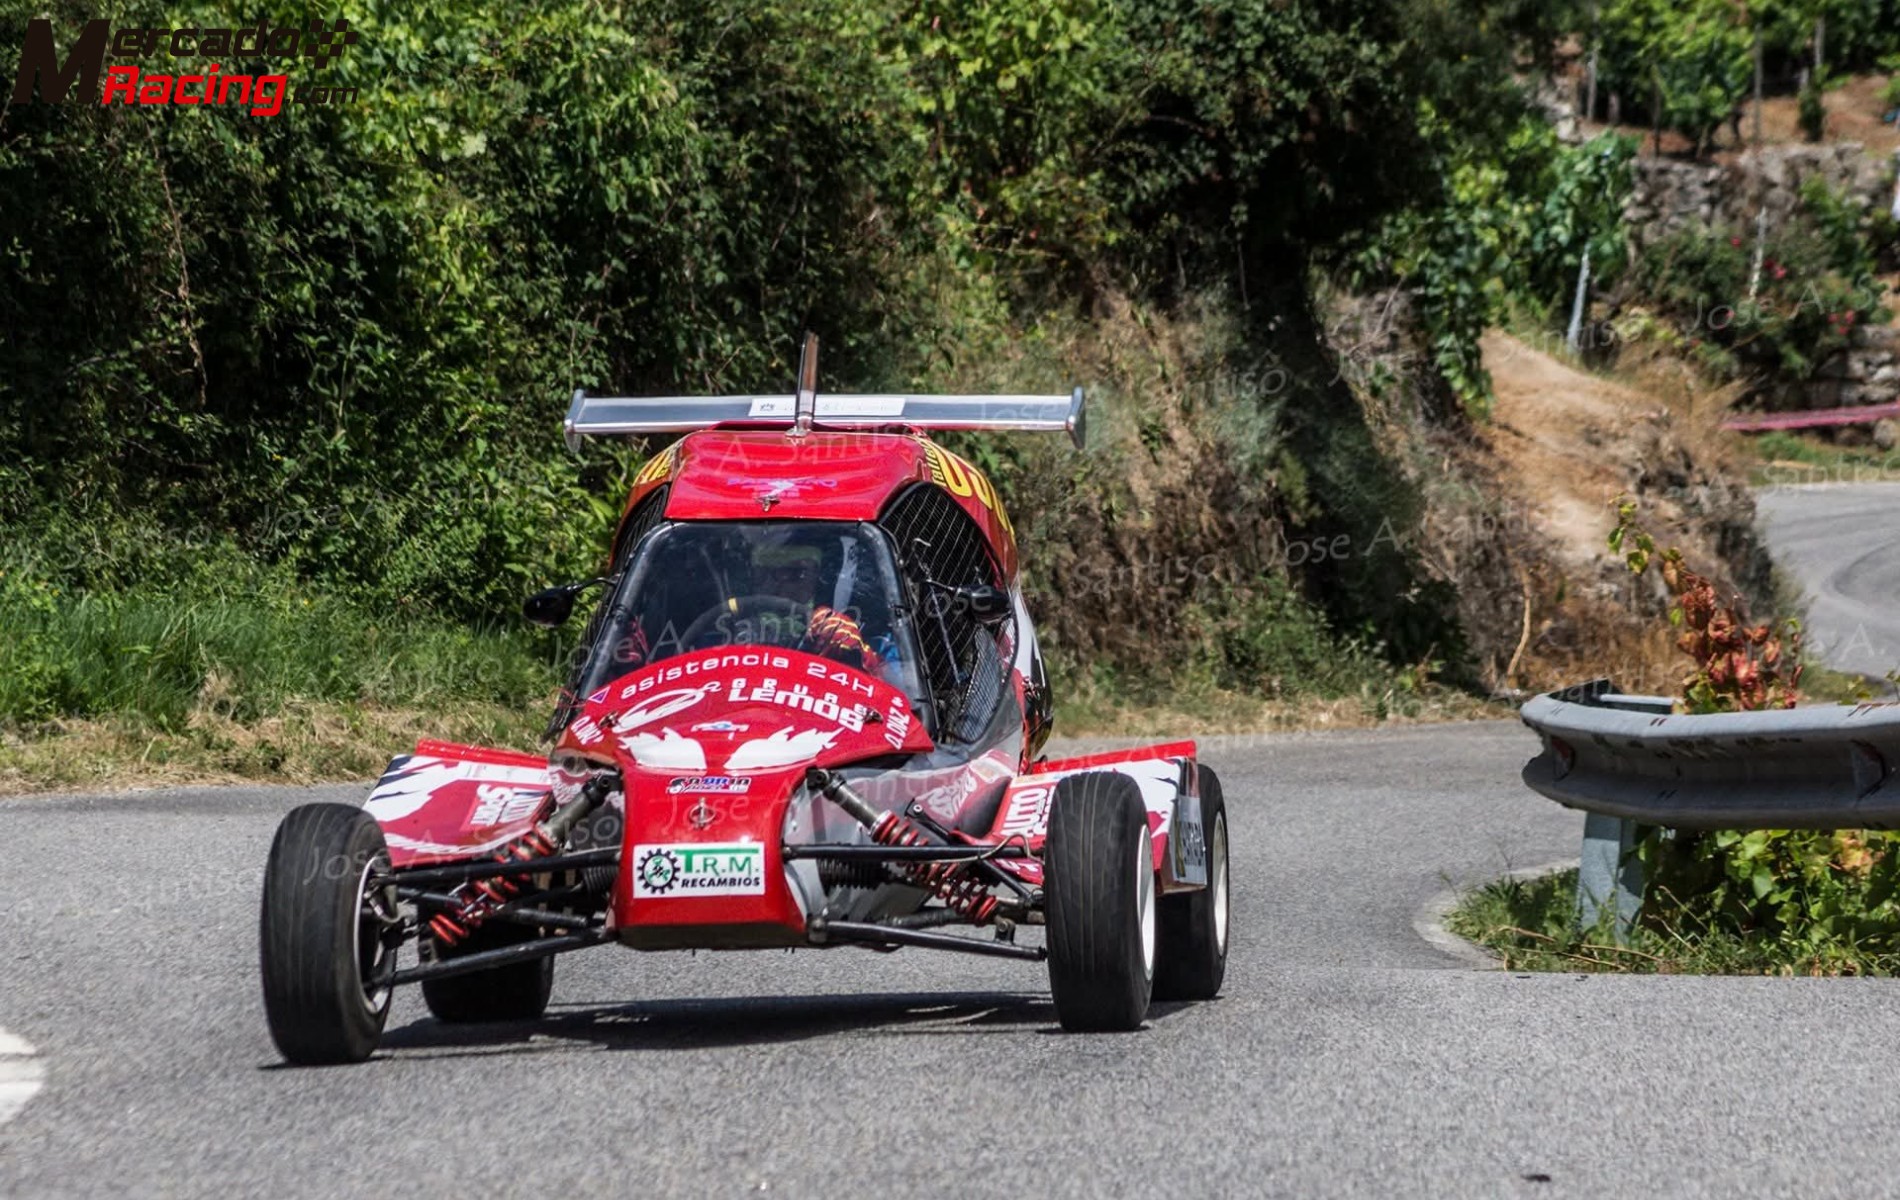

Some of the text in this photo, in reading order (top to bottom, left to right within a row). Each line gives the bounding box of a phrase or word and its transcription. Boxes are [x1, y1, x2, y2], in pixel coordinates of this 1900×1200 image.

[620, 651, 875, 699] asistencia 24H
[672, 847, 761, 878] T.R.M.
[680, 875, 762, 889] RECAMBIOS
